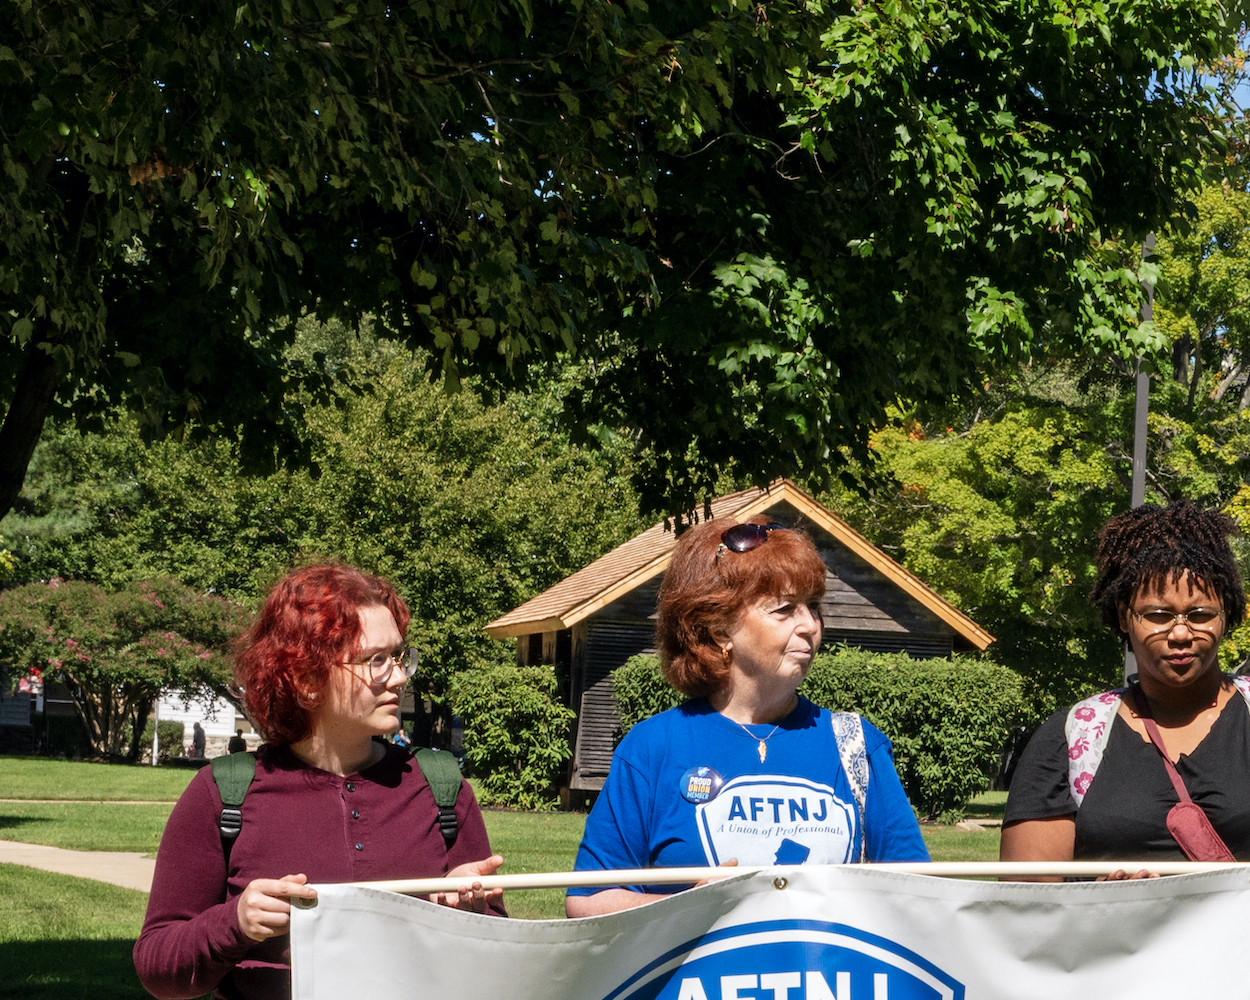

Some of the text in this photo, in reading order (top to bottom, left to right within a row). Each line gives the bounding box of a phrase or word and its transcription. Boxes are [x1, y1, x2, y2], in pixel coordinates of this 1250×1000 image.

[689, 776, 712, 786] PROUD
[688, 784, 710, 794] UNION
[686, 791, 710, 800] MEMBER
[727, 795, 828, 824] AFTNJ
[716, 823, 844, 839] A Union of Professionals
